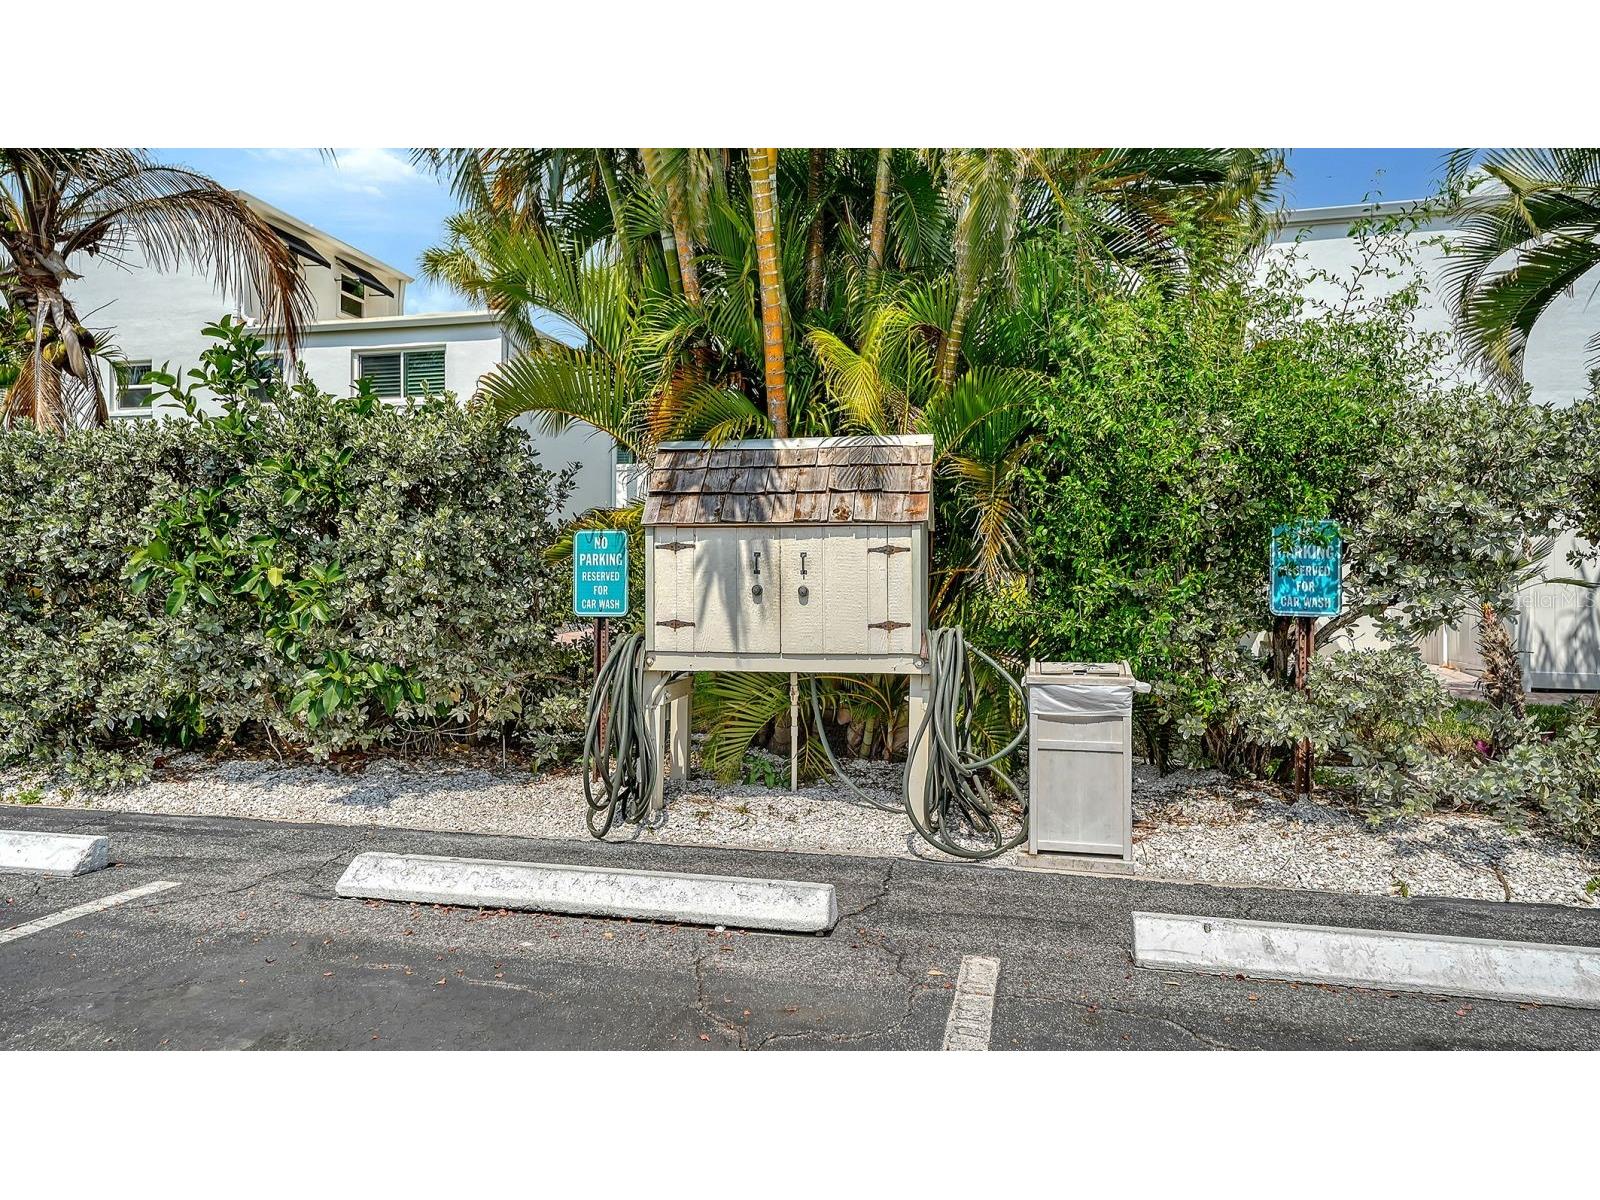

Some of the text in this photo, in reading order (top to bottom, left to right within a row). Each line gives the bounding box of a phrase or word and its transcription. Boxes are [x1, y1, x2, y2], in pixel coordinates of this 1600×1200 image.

[594, 536, 608, 550] NO
[580, 553, 623, 566] PARKING
[582, 571, 620, 581] RESERVED
[593, 585, 608, 595] FOR
[1296, 580, 1315, 592] FOR
[581, 599, 620, 609] CAR WASH
[1280, 596, 1331, 608] CAR WASH
